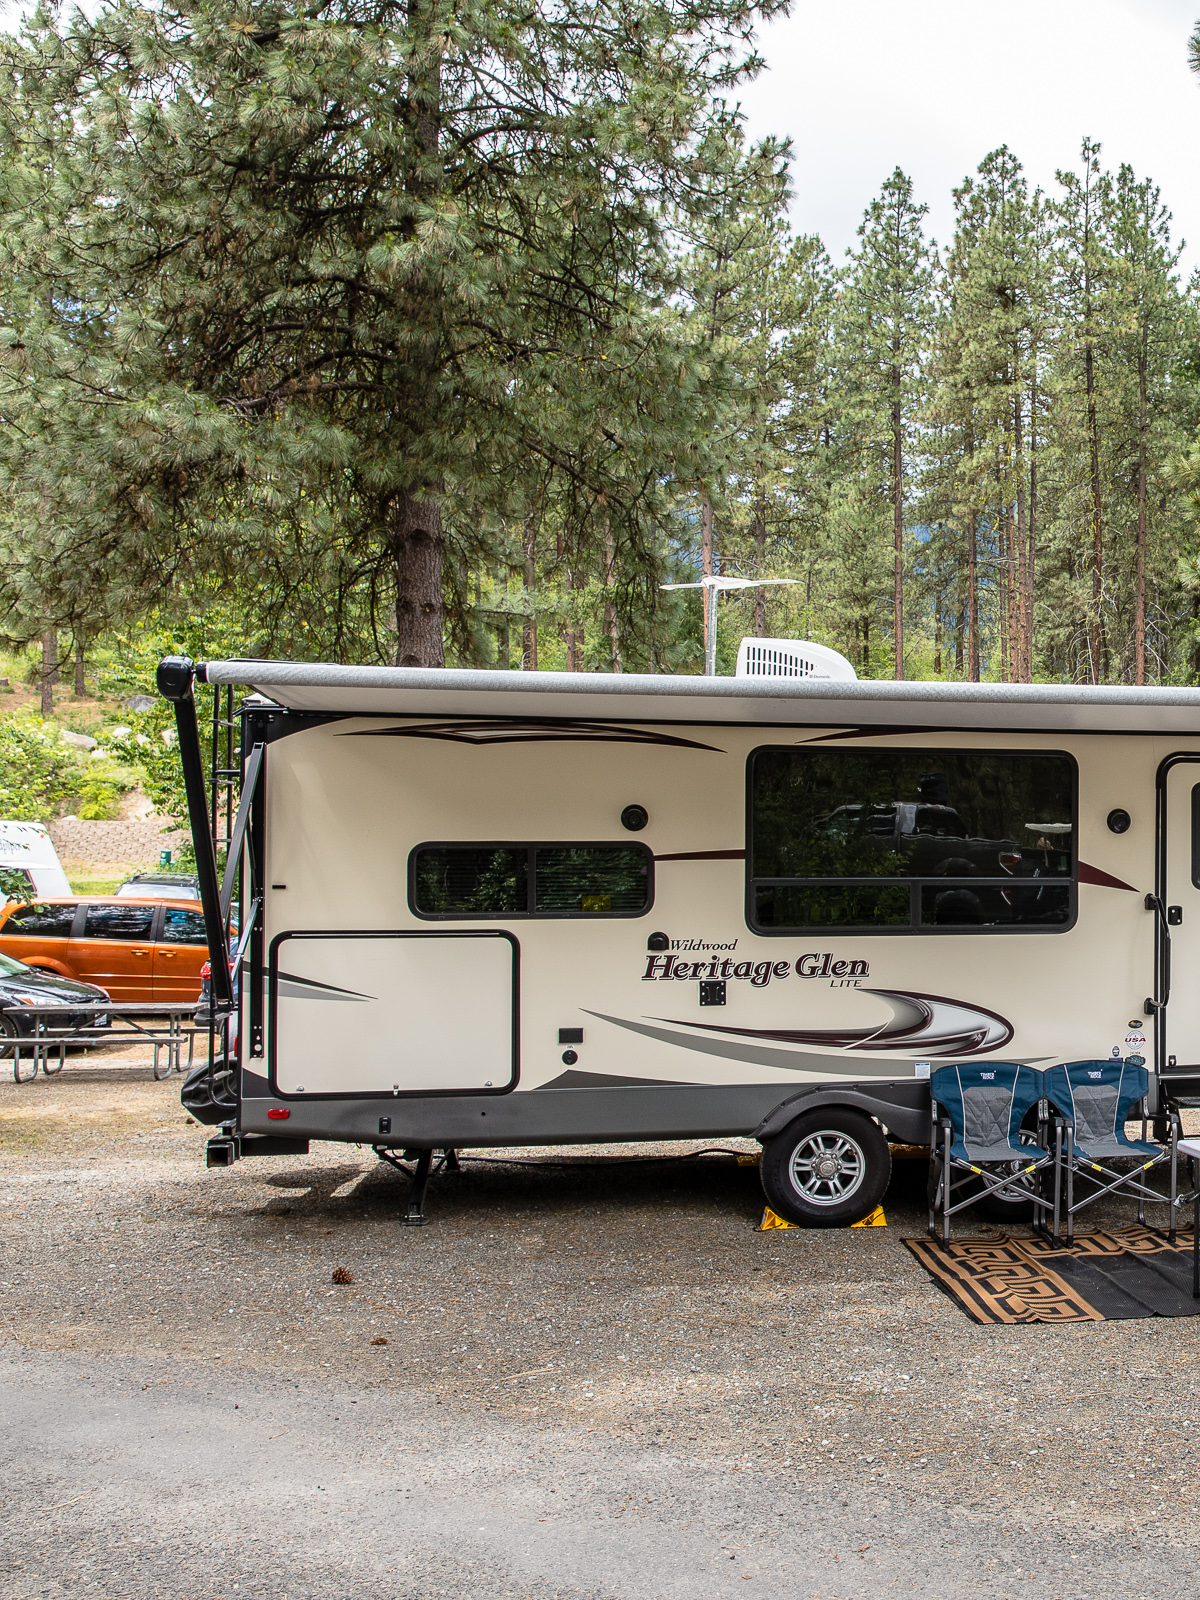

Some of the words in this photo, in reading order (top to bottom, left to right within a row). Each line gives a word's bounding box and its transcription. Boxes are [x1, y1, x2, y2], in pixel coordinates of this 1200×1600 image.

[670, 938, 738, 951] Wildwood
[641, 954, 790, 988] Heritage
[795, 952, 870, 979] Glen
[829, 979, 863, 988] LITE
